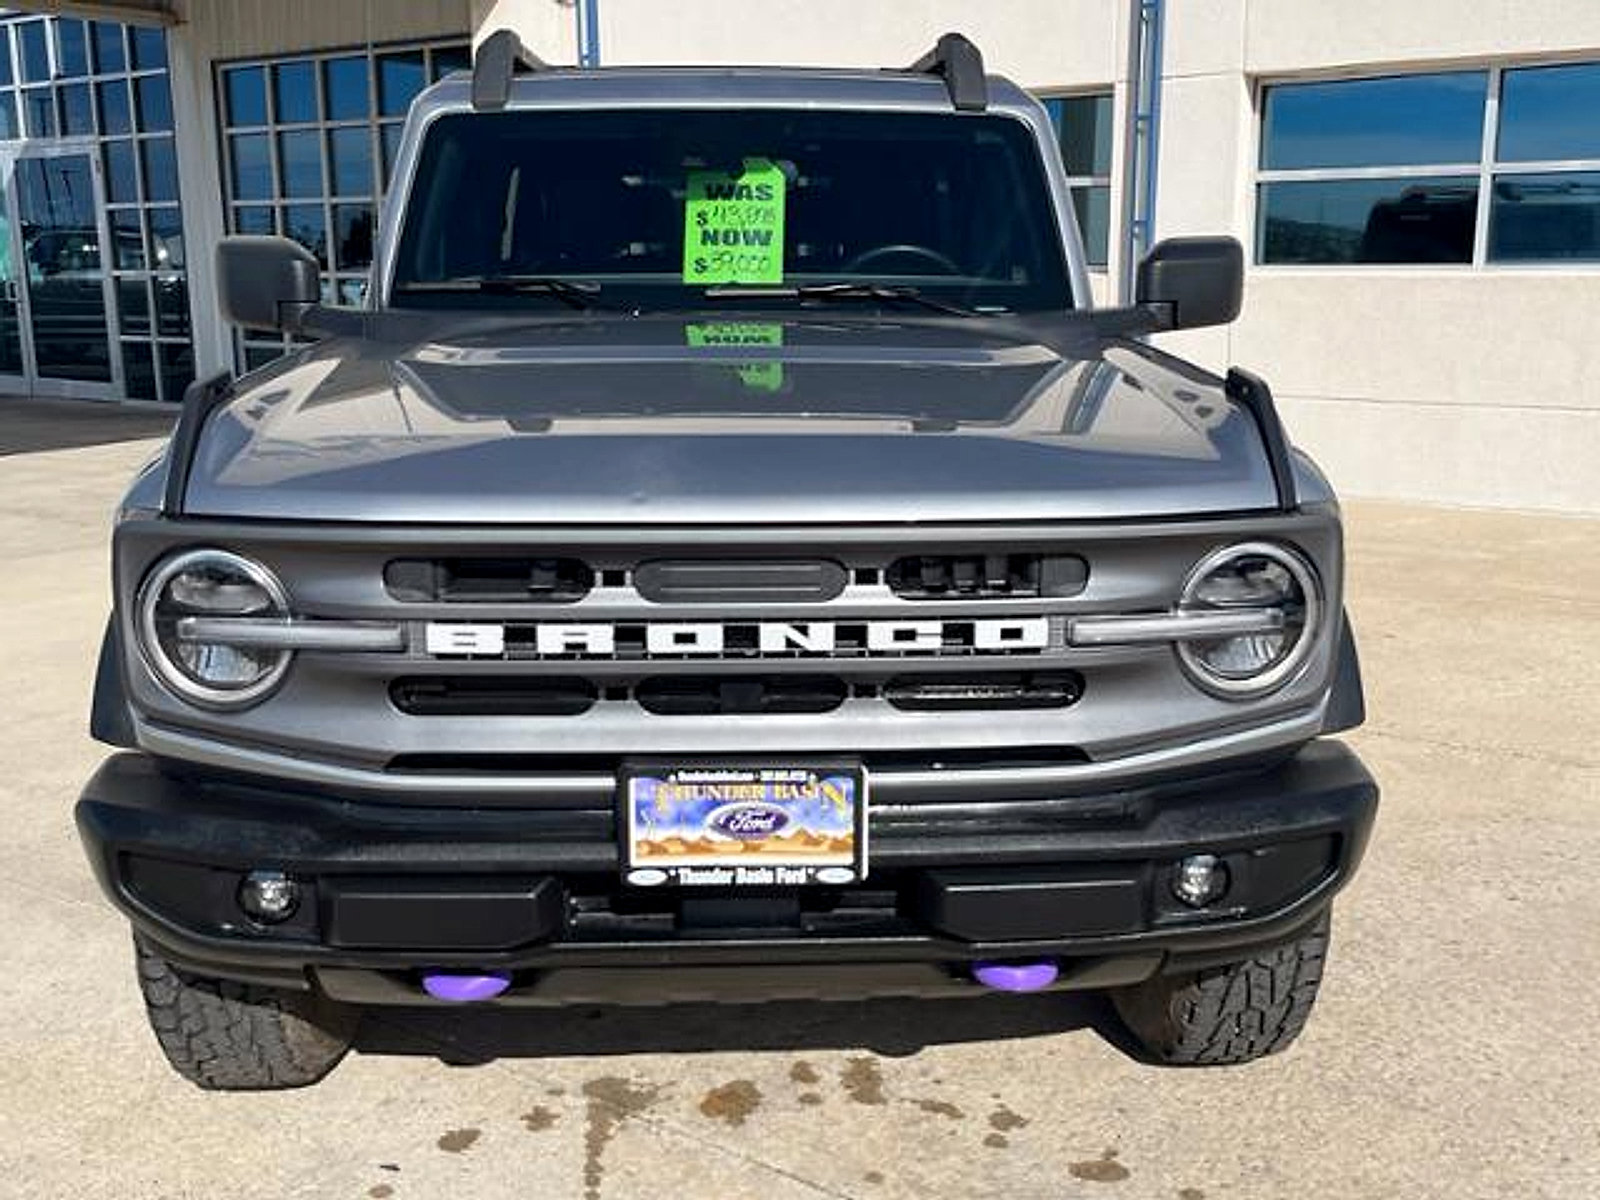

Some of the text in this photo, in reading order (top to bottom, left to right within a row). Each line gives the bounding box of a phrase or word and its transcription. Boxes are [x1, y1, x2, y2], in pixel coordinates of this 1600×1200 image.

[705, 182, 774, 201] WAS
[700, 229, 774, 246] NOW
[425, 618, 1049, 654] BRONCO
[728, 809, 778, 832] Ford
[776, 866, 808, 885] Ford
